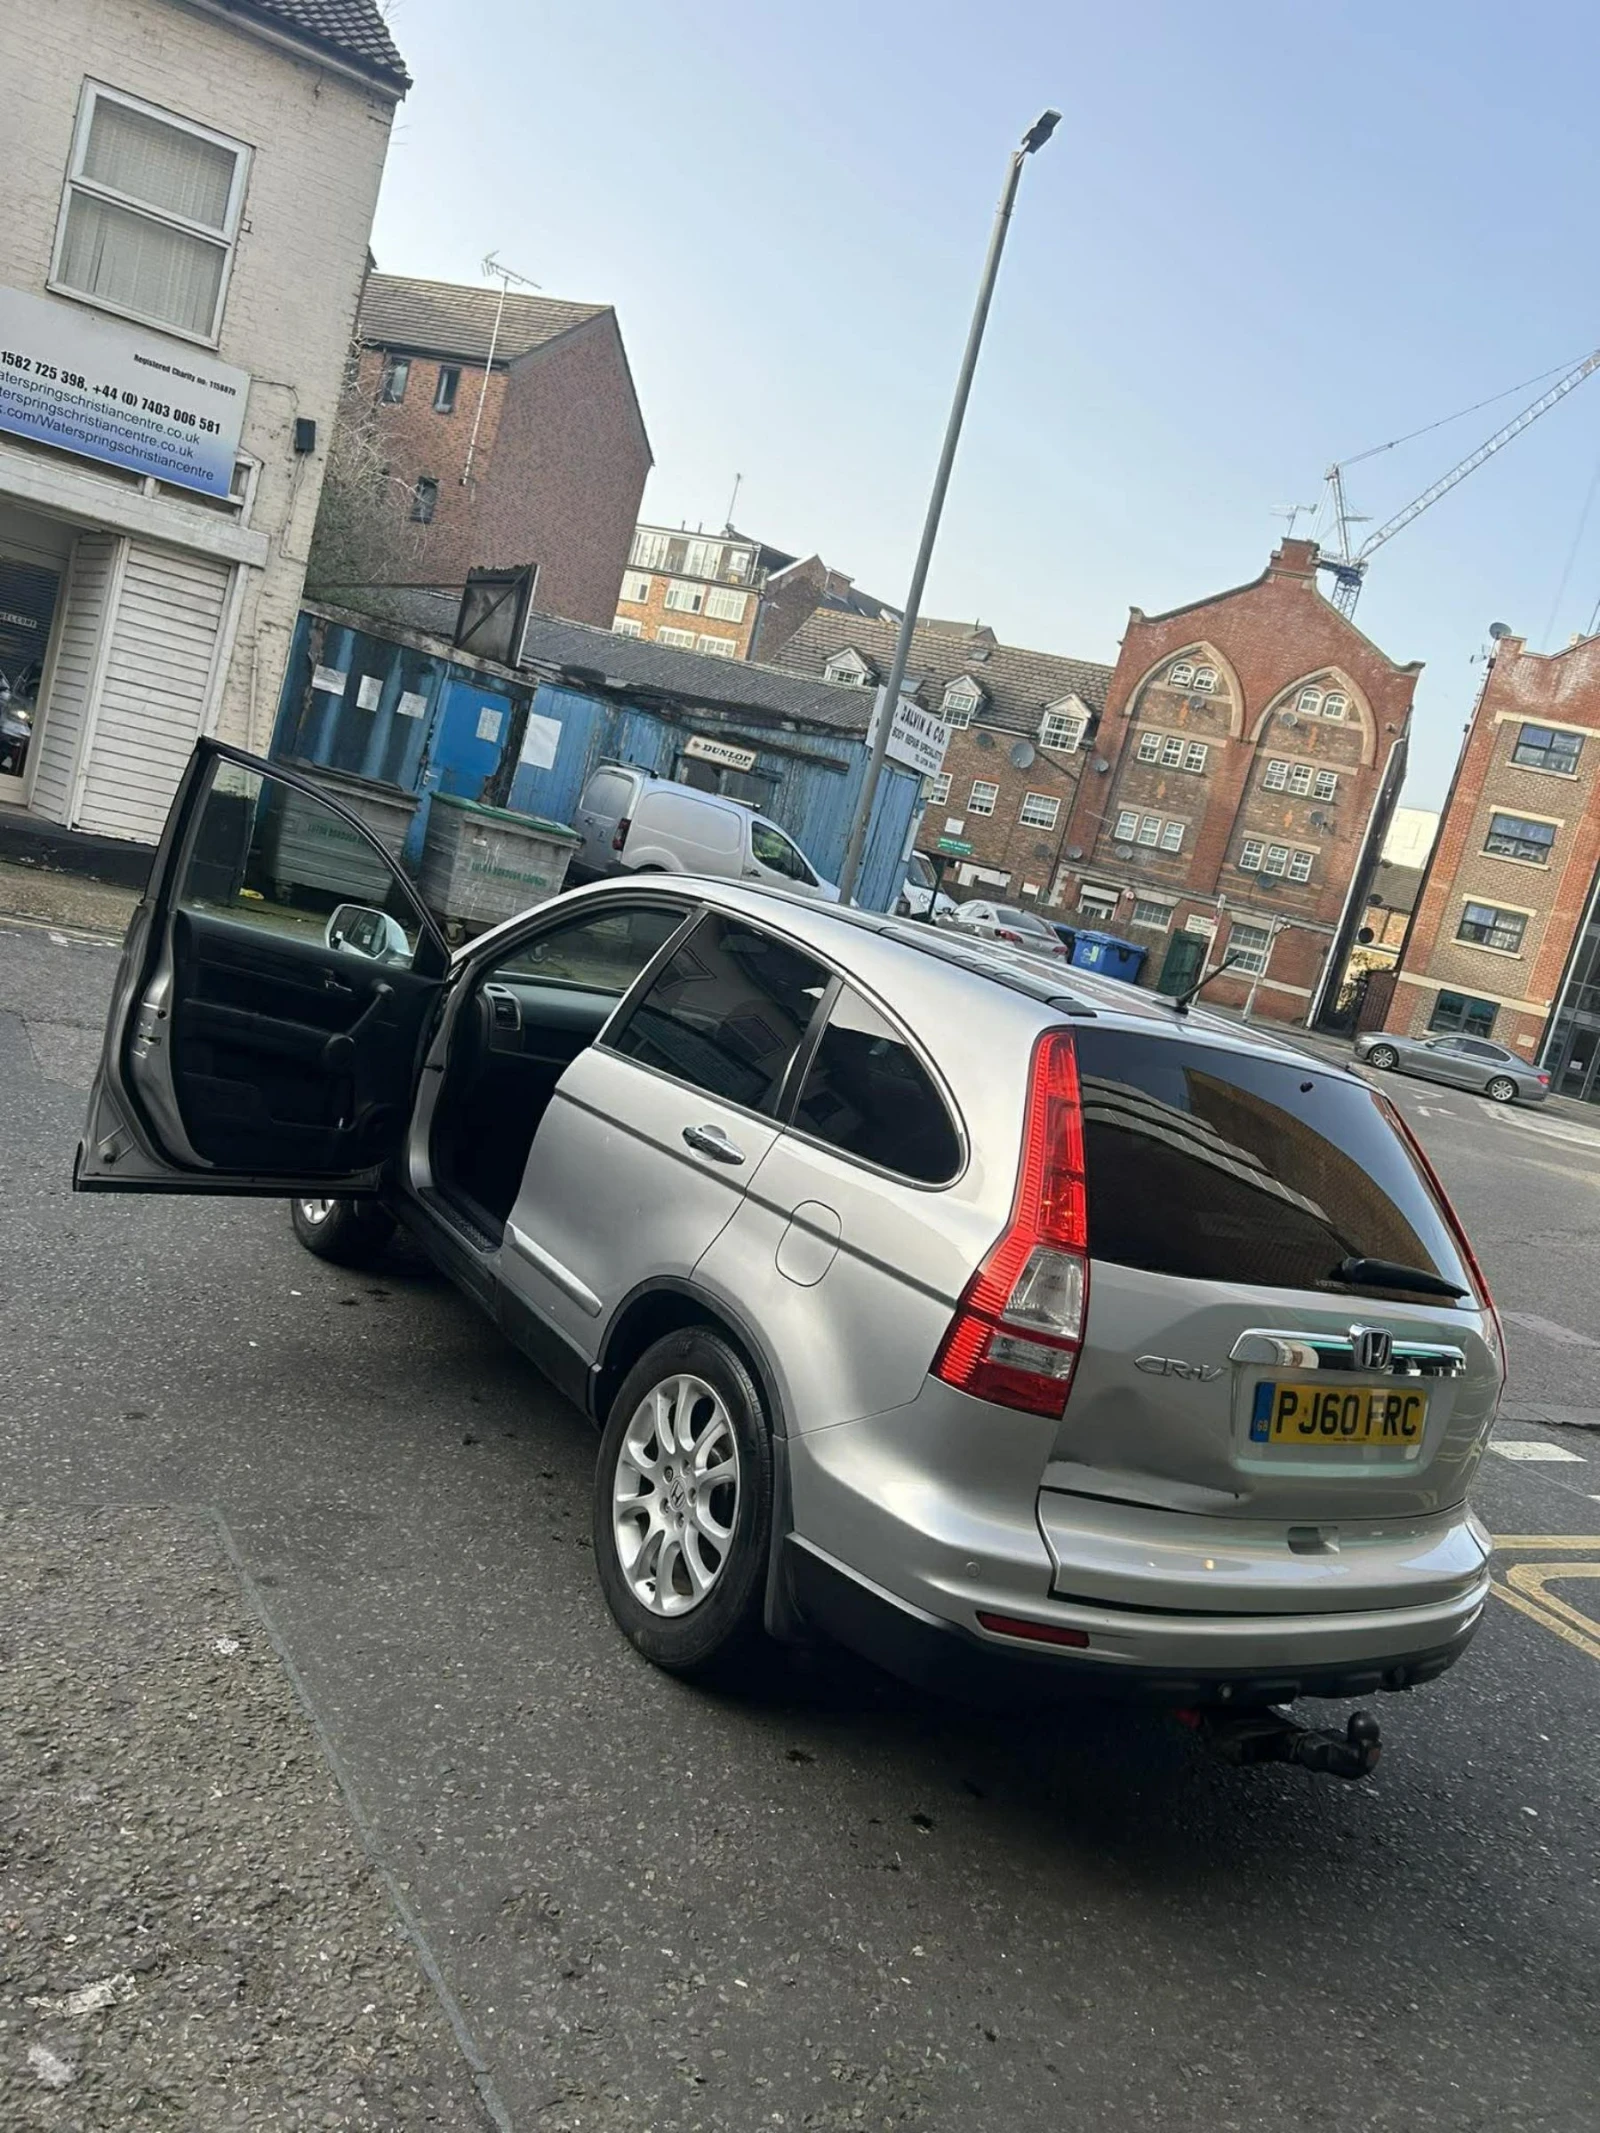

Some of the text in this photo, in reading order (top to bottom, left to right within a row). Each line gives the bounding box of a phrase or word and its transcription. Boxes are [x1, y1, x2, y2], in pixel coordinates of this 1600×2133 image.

[134, 354, 171, 373] Registered
[171, 367, 196, 382] Charity
[0, 351, 31, 371] 1582
[34, 362, 57, 380] 725
[93, 385, 118, 400] +44
[121, 391, 138, 407] (0)
[141, 398, 171, 418] 7403
[173, 409, 196, 426] 006
[199, 417, 221, 435] 581
[703, 744, 752, 762] DUNLOP
[1276, 1390, 1359, 1435] PJ60
